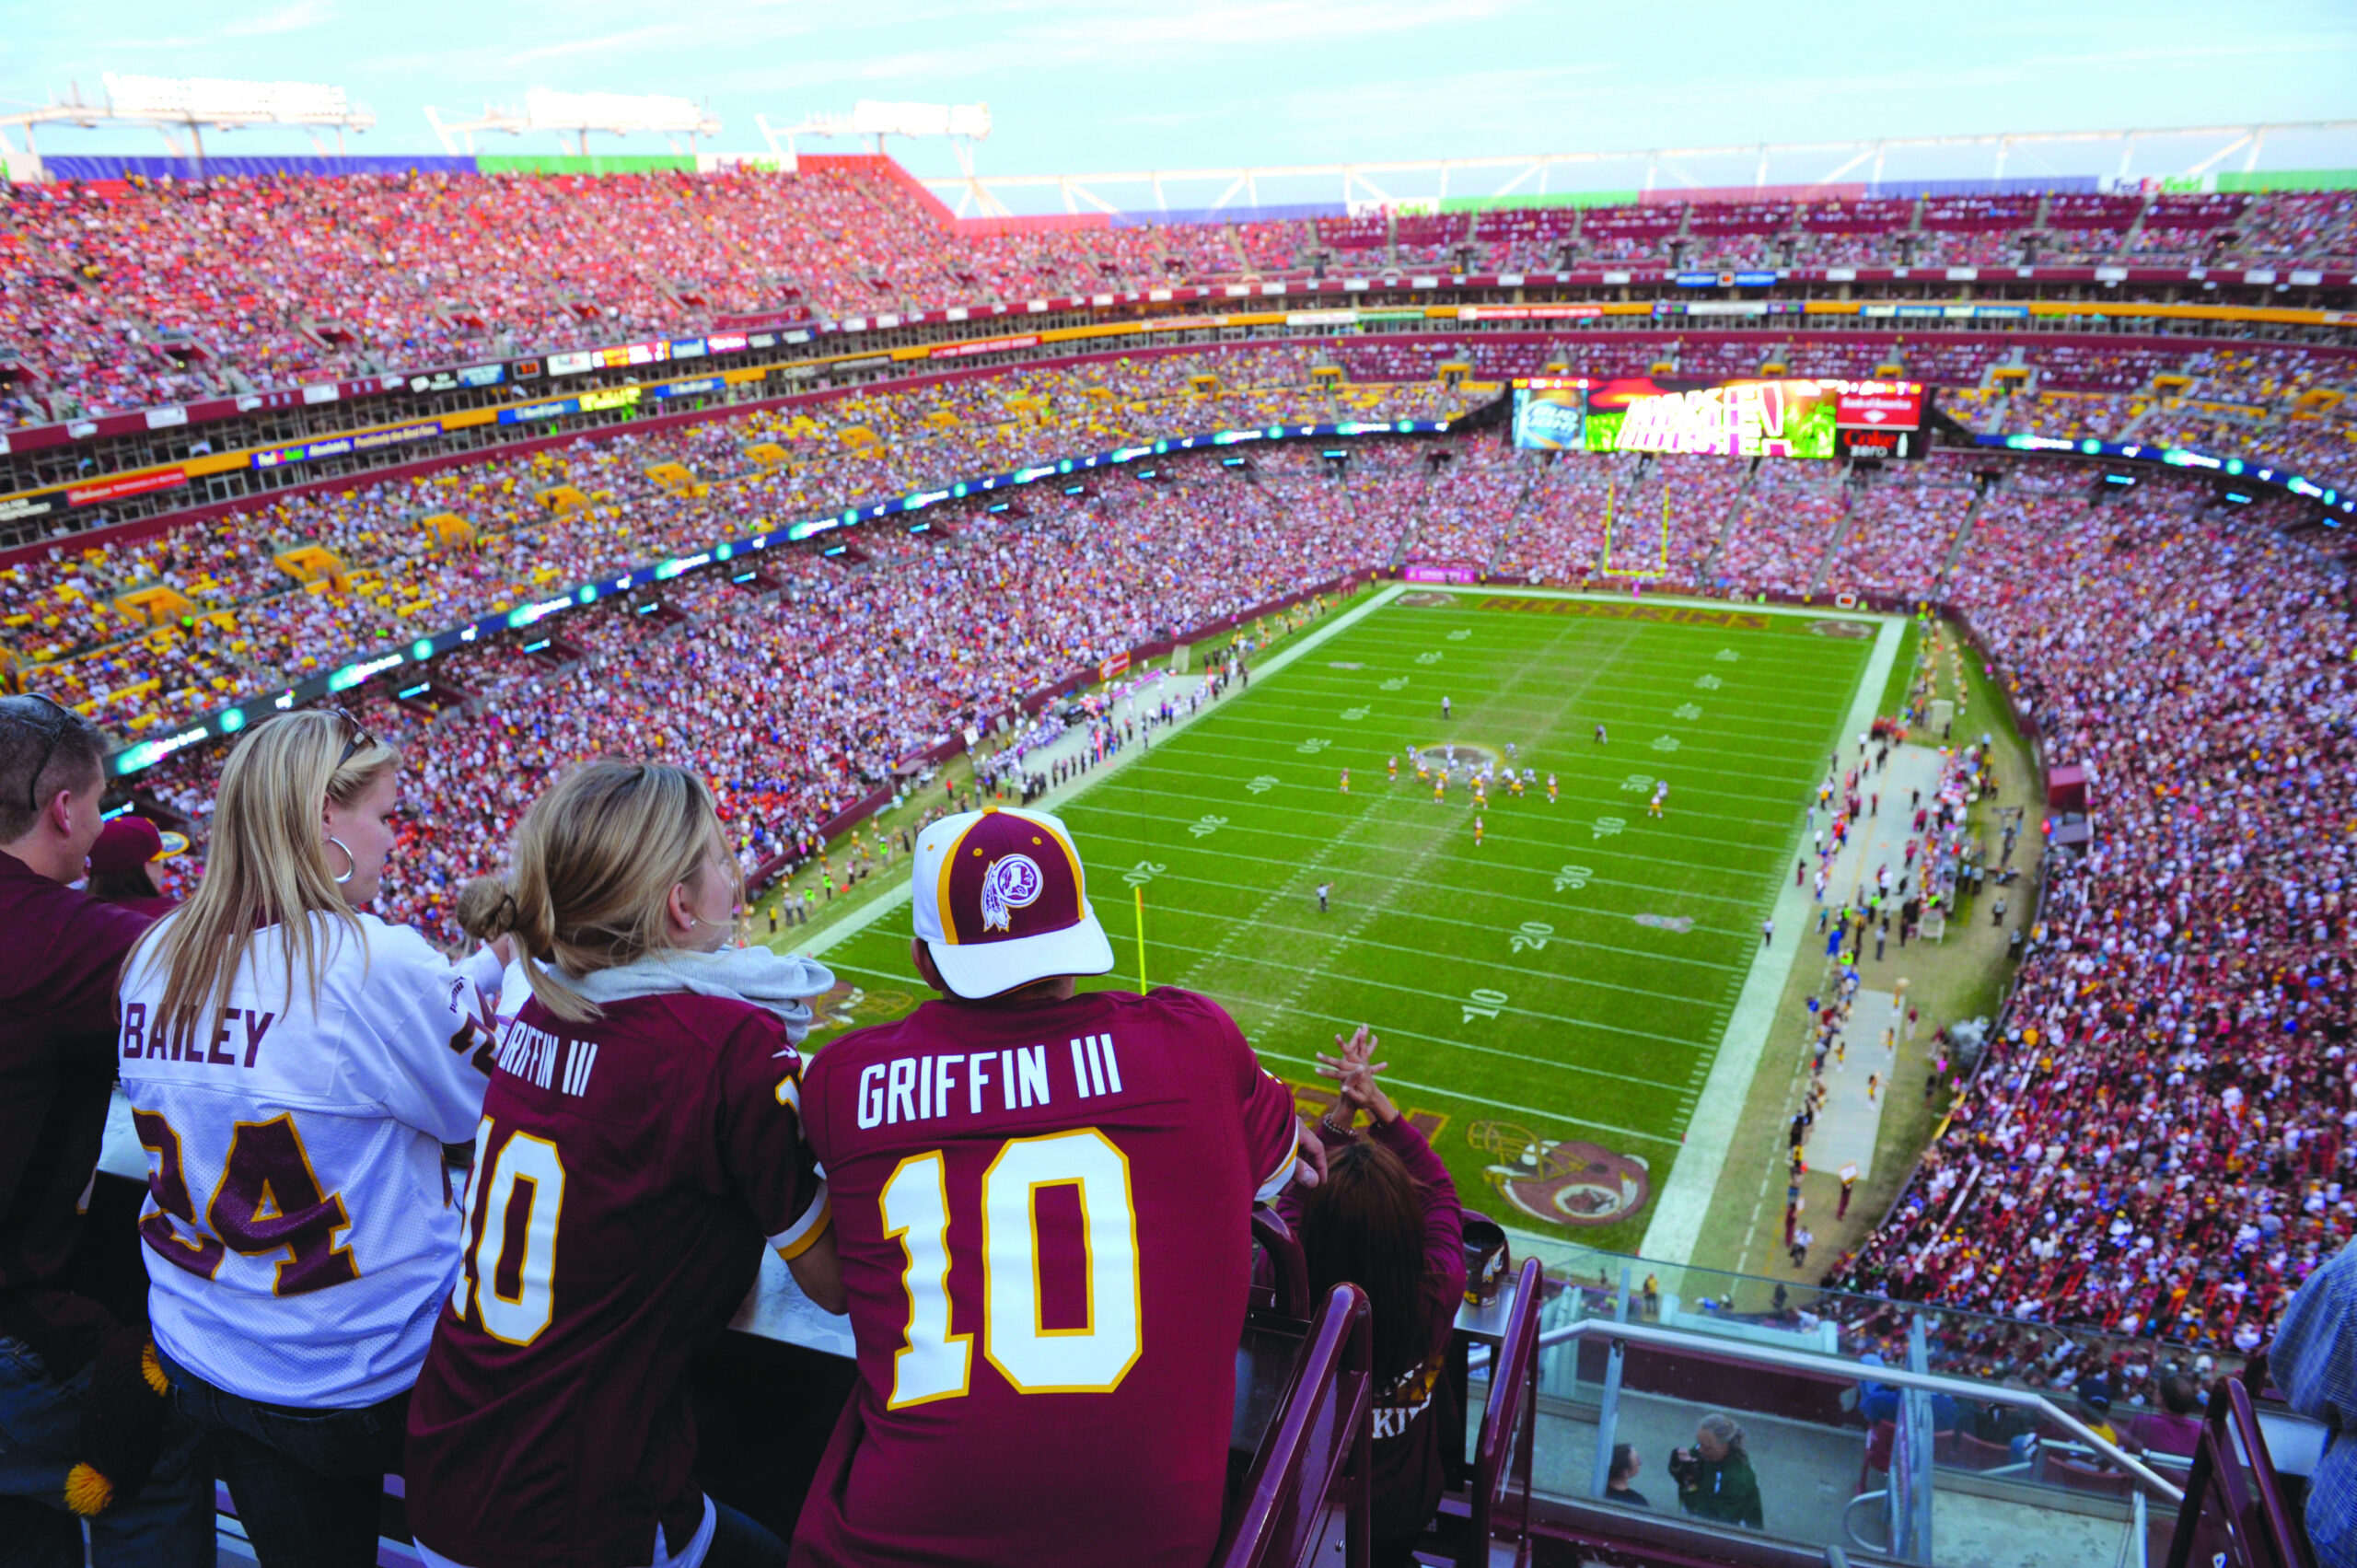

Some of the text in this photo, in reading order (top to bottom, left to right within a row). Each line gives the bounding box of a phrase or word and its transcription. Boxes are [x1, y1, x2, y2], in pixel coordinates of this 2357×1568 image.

[1843, 429, 1898, 448] Coke
[1850, 444, 1888, 459] zero
[1477, 596, 1772, 630] REDSKINS
[1553, 865, 1593, 890] 30
[1510, 922, 1554, 951] 20
[1462, 989, 1508, 1021] 10
[122, 1002, 274, 1069] BAILEY
[562, 1039, 598, 1098] III
[857, 1044, 1051, 1130] GRIFFIN
[1070, 1032, 1122, 1099] III
[131, 1107, 361, 1296] 24
[451, 1114, 566, 1347] 10
[878, 1125, 1143, 1411] 10
